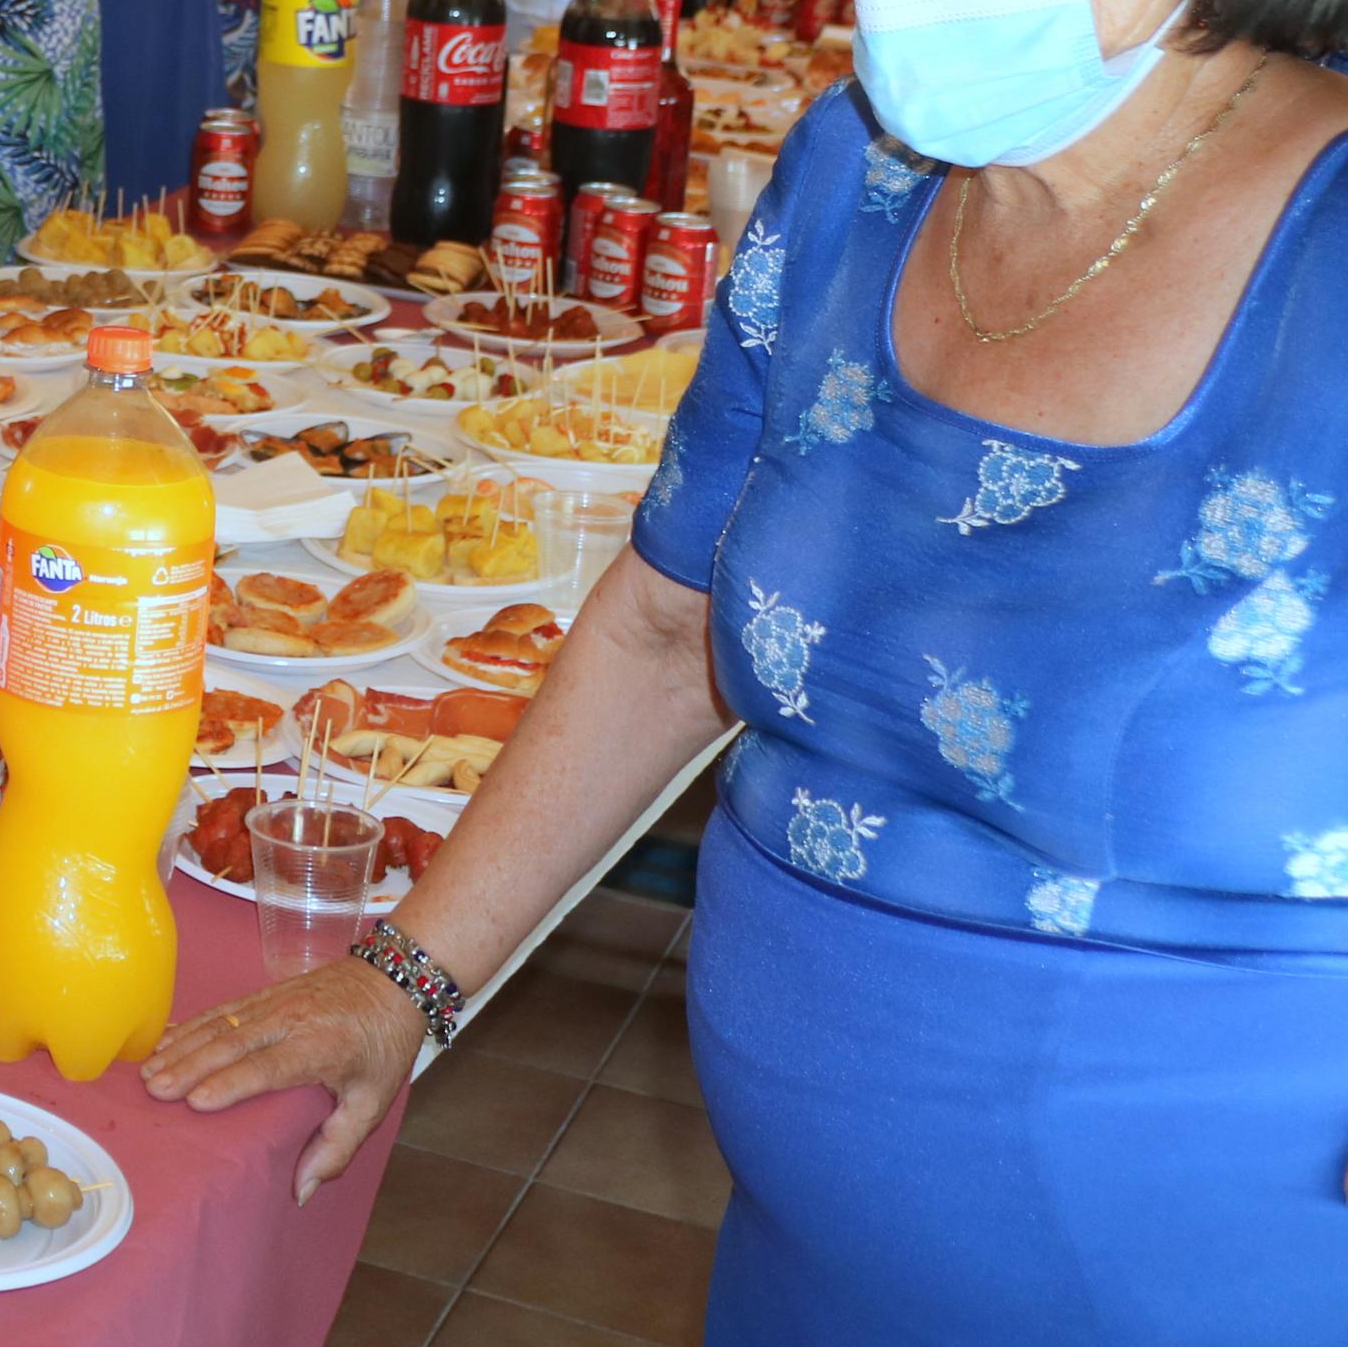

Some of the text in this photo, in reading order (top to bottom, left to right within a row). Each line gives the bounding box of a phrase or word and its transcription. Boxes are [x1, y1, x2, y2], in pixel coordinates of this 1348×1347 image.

[437, 31, 505, 74] Coca-C
[31, 553, 82, 581] FANTA
[71, 604, 81, 624] 2
[83, 610, 117, 627] Litros
